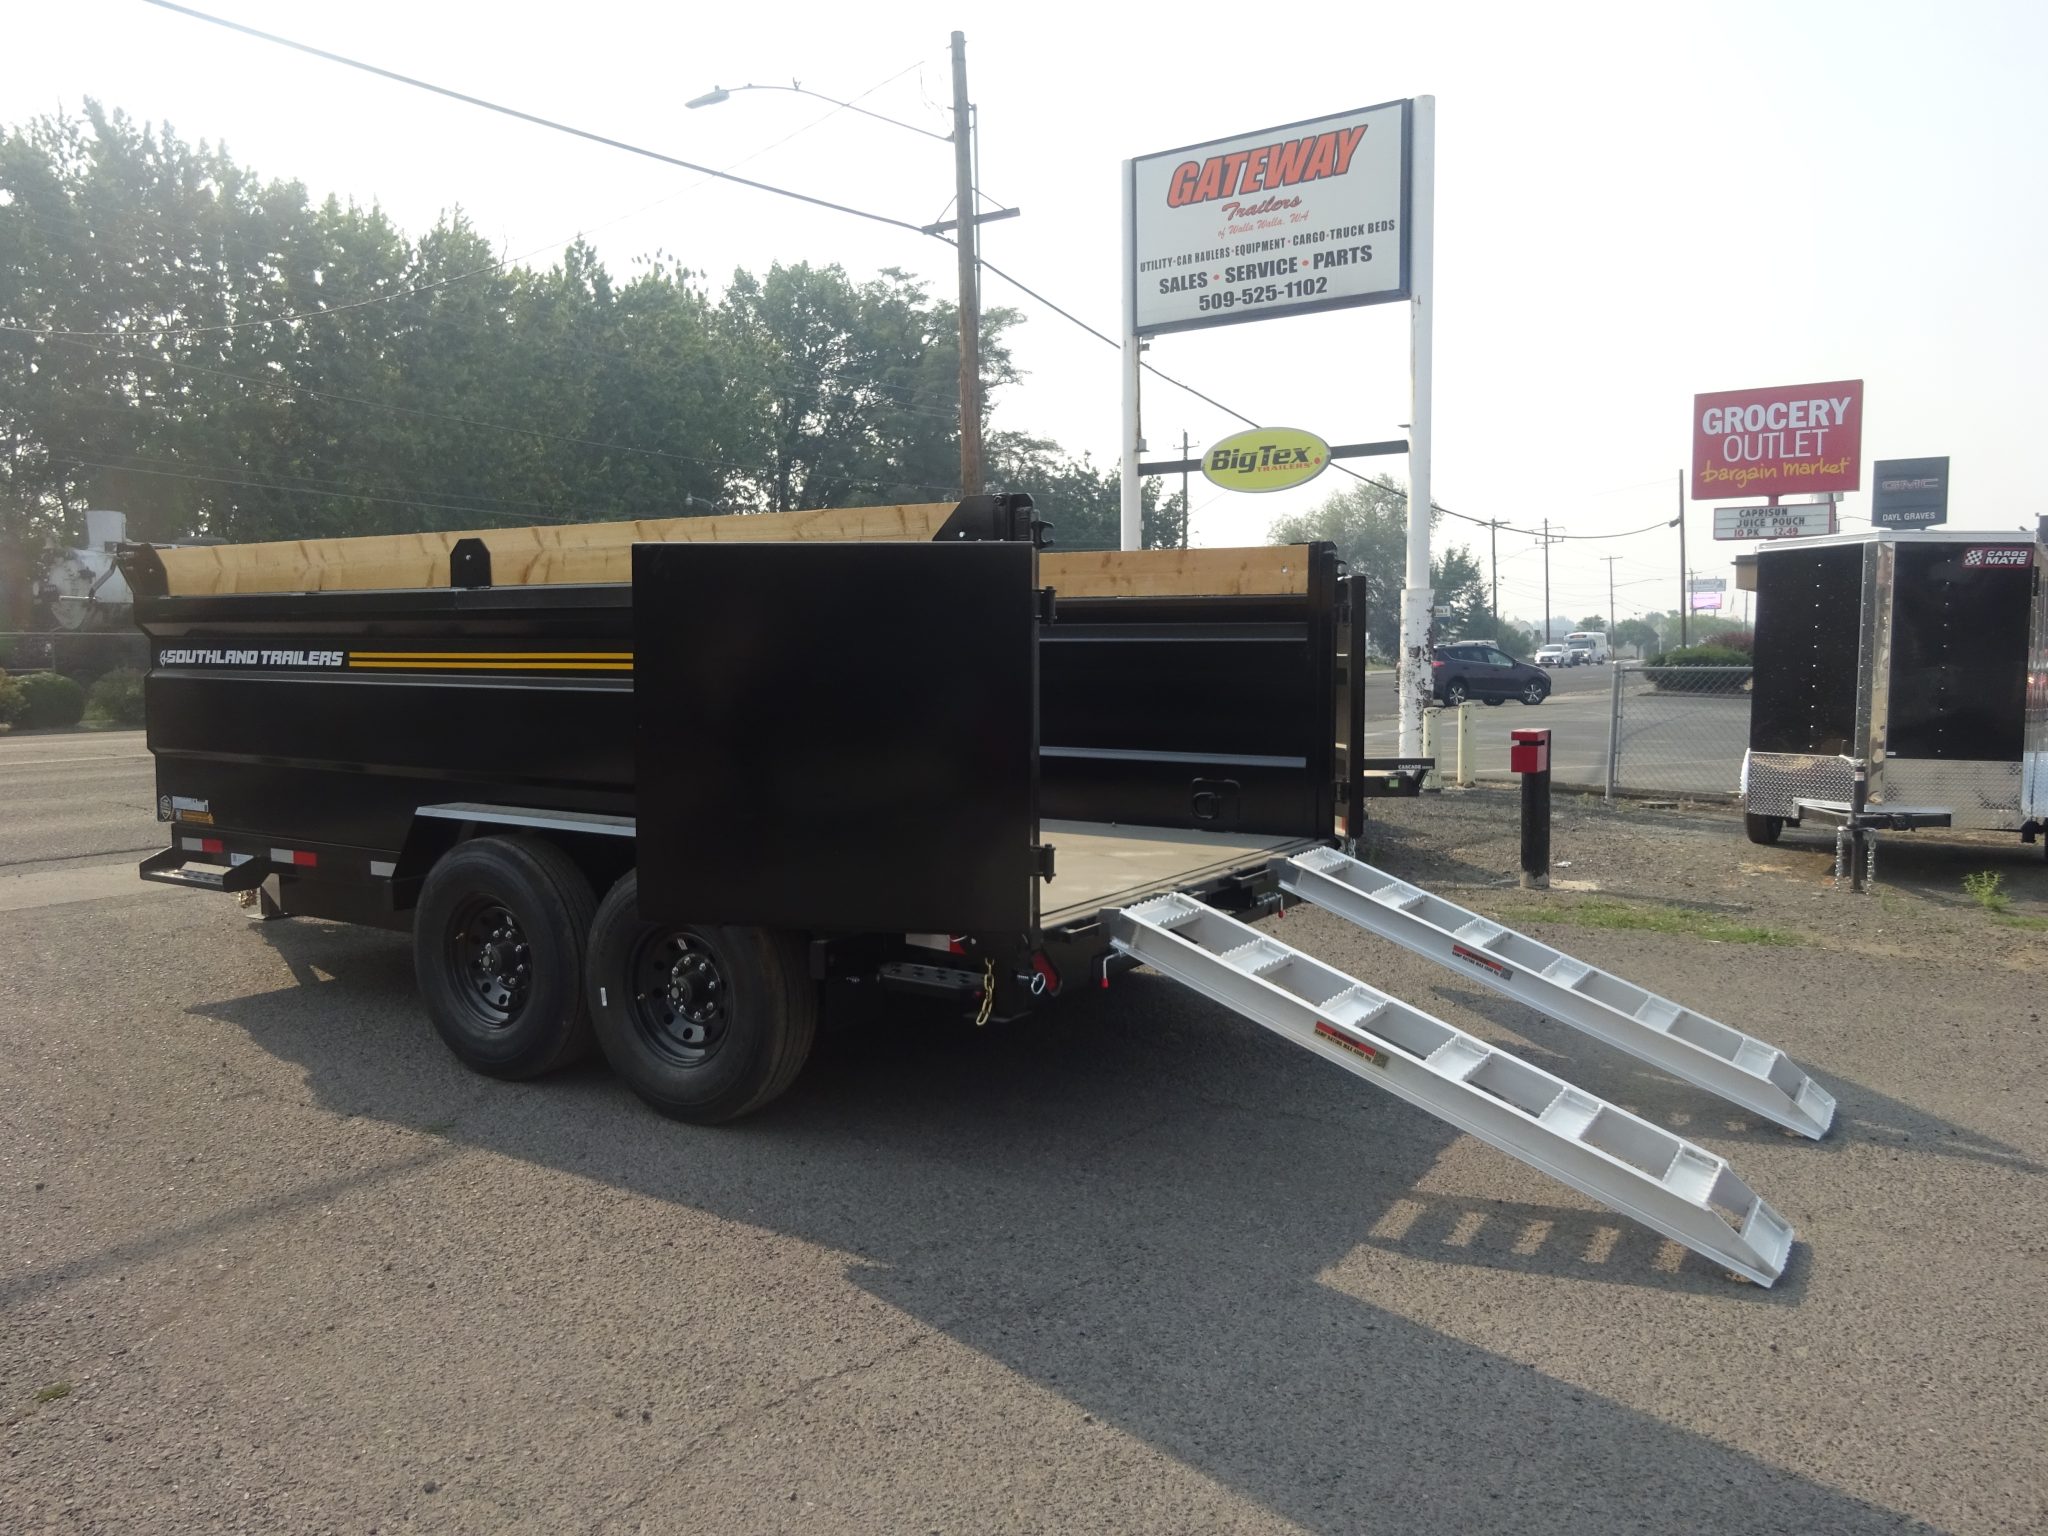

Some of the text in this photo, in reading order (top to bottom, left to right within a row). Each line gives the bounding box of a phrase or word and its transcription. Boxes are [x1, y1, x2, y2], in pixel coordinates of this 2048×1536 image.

[1167, 124, 1368, 208] GATEWAY
[1222, 196, 1302, 221] Trailers
[1229, 222, 1254, 234] Walla
[1290, 210, 1309, 223] WA
[1140, 219, 1395, 272] UTILITY CAR HAULERS EQUIPMENT CARGO TRUCK BEDS
[1159, 245, 1373, 294] SALES SERVICE PARTS
[1199, 276, 1328, 311] 509-525-1102
[1702, 397, 1852, 435] GROCERY
[1723, 429, 1829, 462] OUTLET
[1257, 462, 1309, 472] TRAILERS
[1700, 459, 1850, 488] bargain market
[1882, 478, 1939, 490] GMC
[1737, 517, 1805, 528] JUICE POUCH
[1904, 512, 1936, 520] GRAVES
[1734, 527, 1798, 537] 10 PK $2.49
[1985, 556, 2026, 565] MATE
[167, 650, 344, 666] SOUTHLAND TRAILERS
